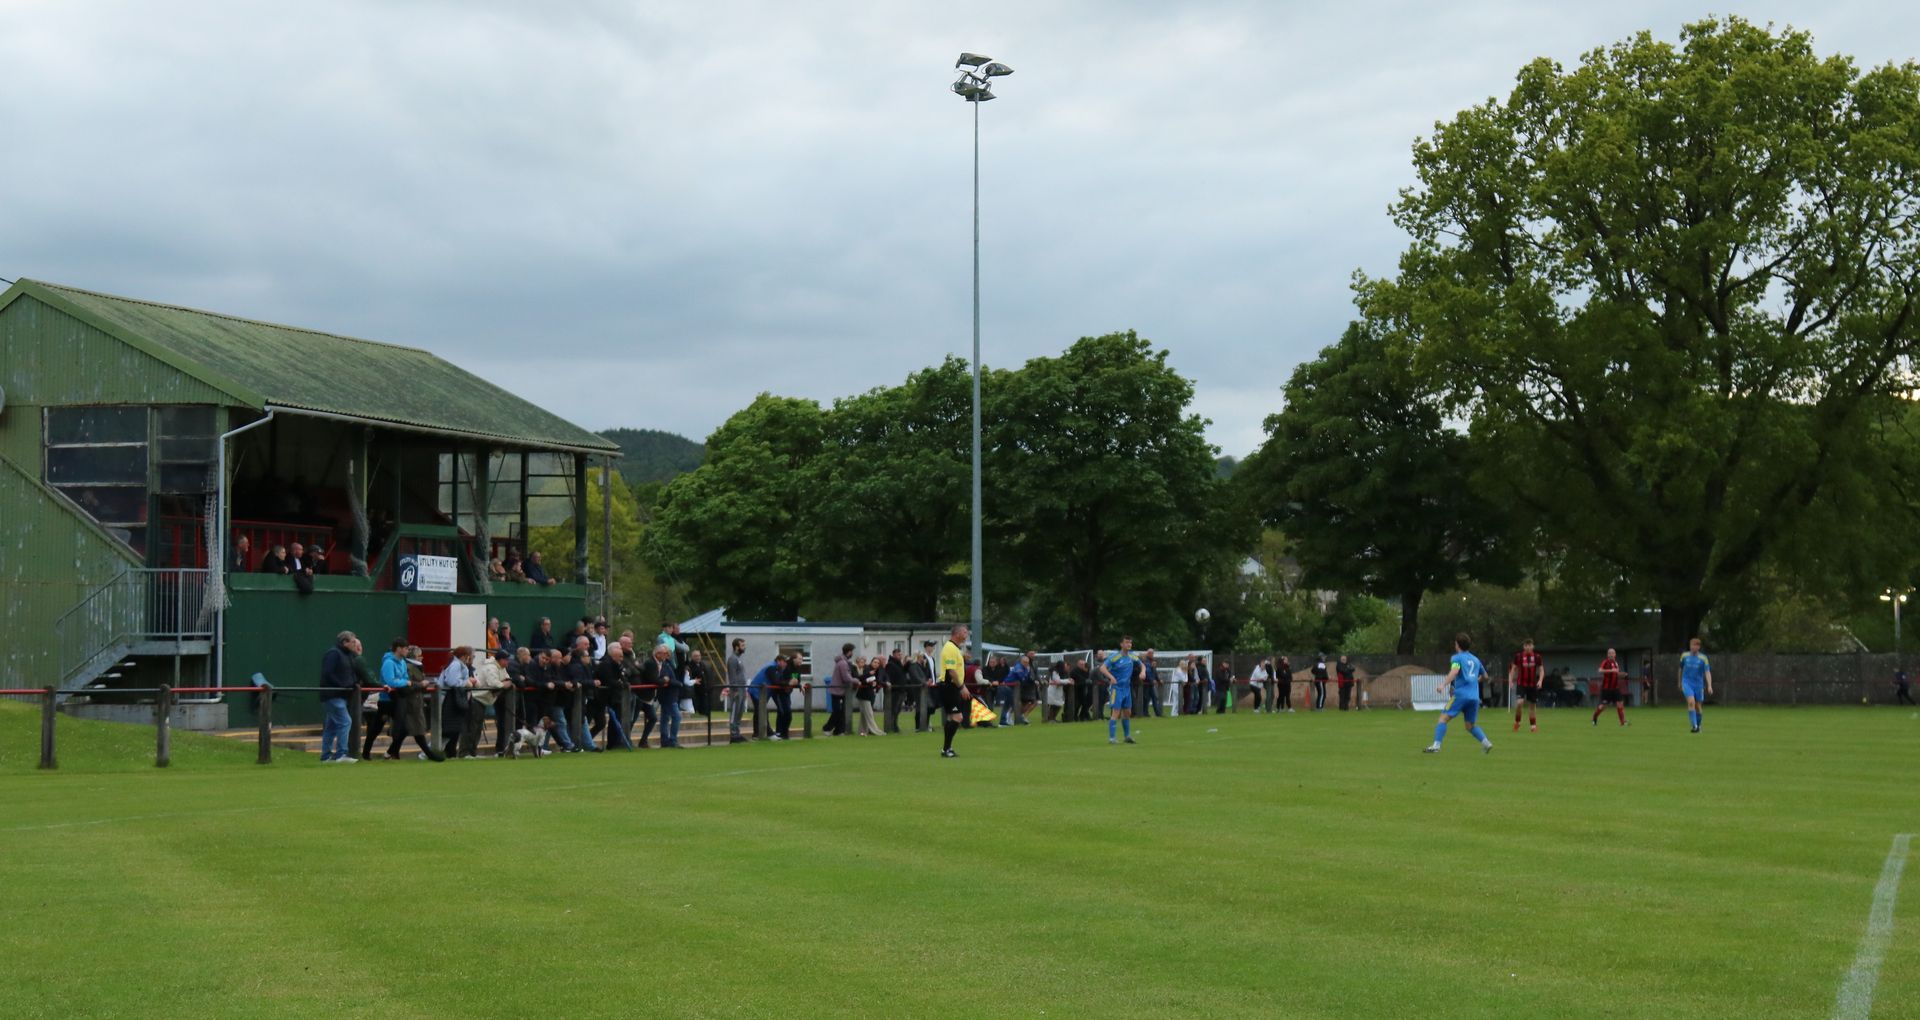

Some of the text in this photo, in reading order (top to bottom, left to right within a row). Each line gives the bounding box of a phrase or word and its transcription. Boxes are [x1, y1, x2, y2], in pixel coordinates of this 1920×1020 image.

[419, 557, 438, 567] UTILITY
[439, 559, 449, 568] HUT
[1467, 660, 1475, 677] 2
